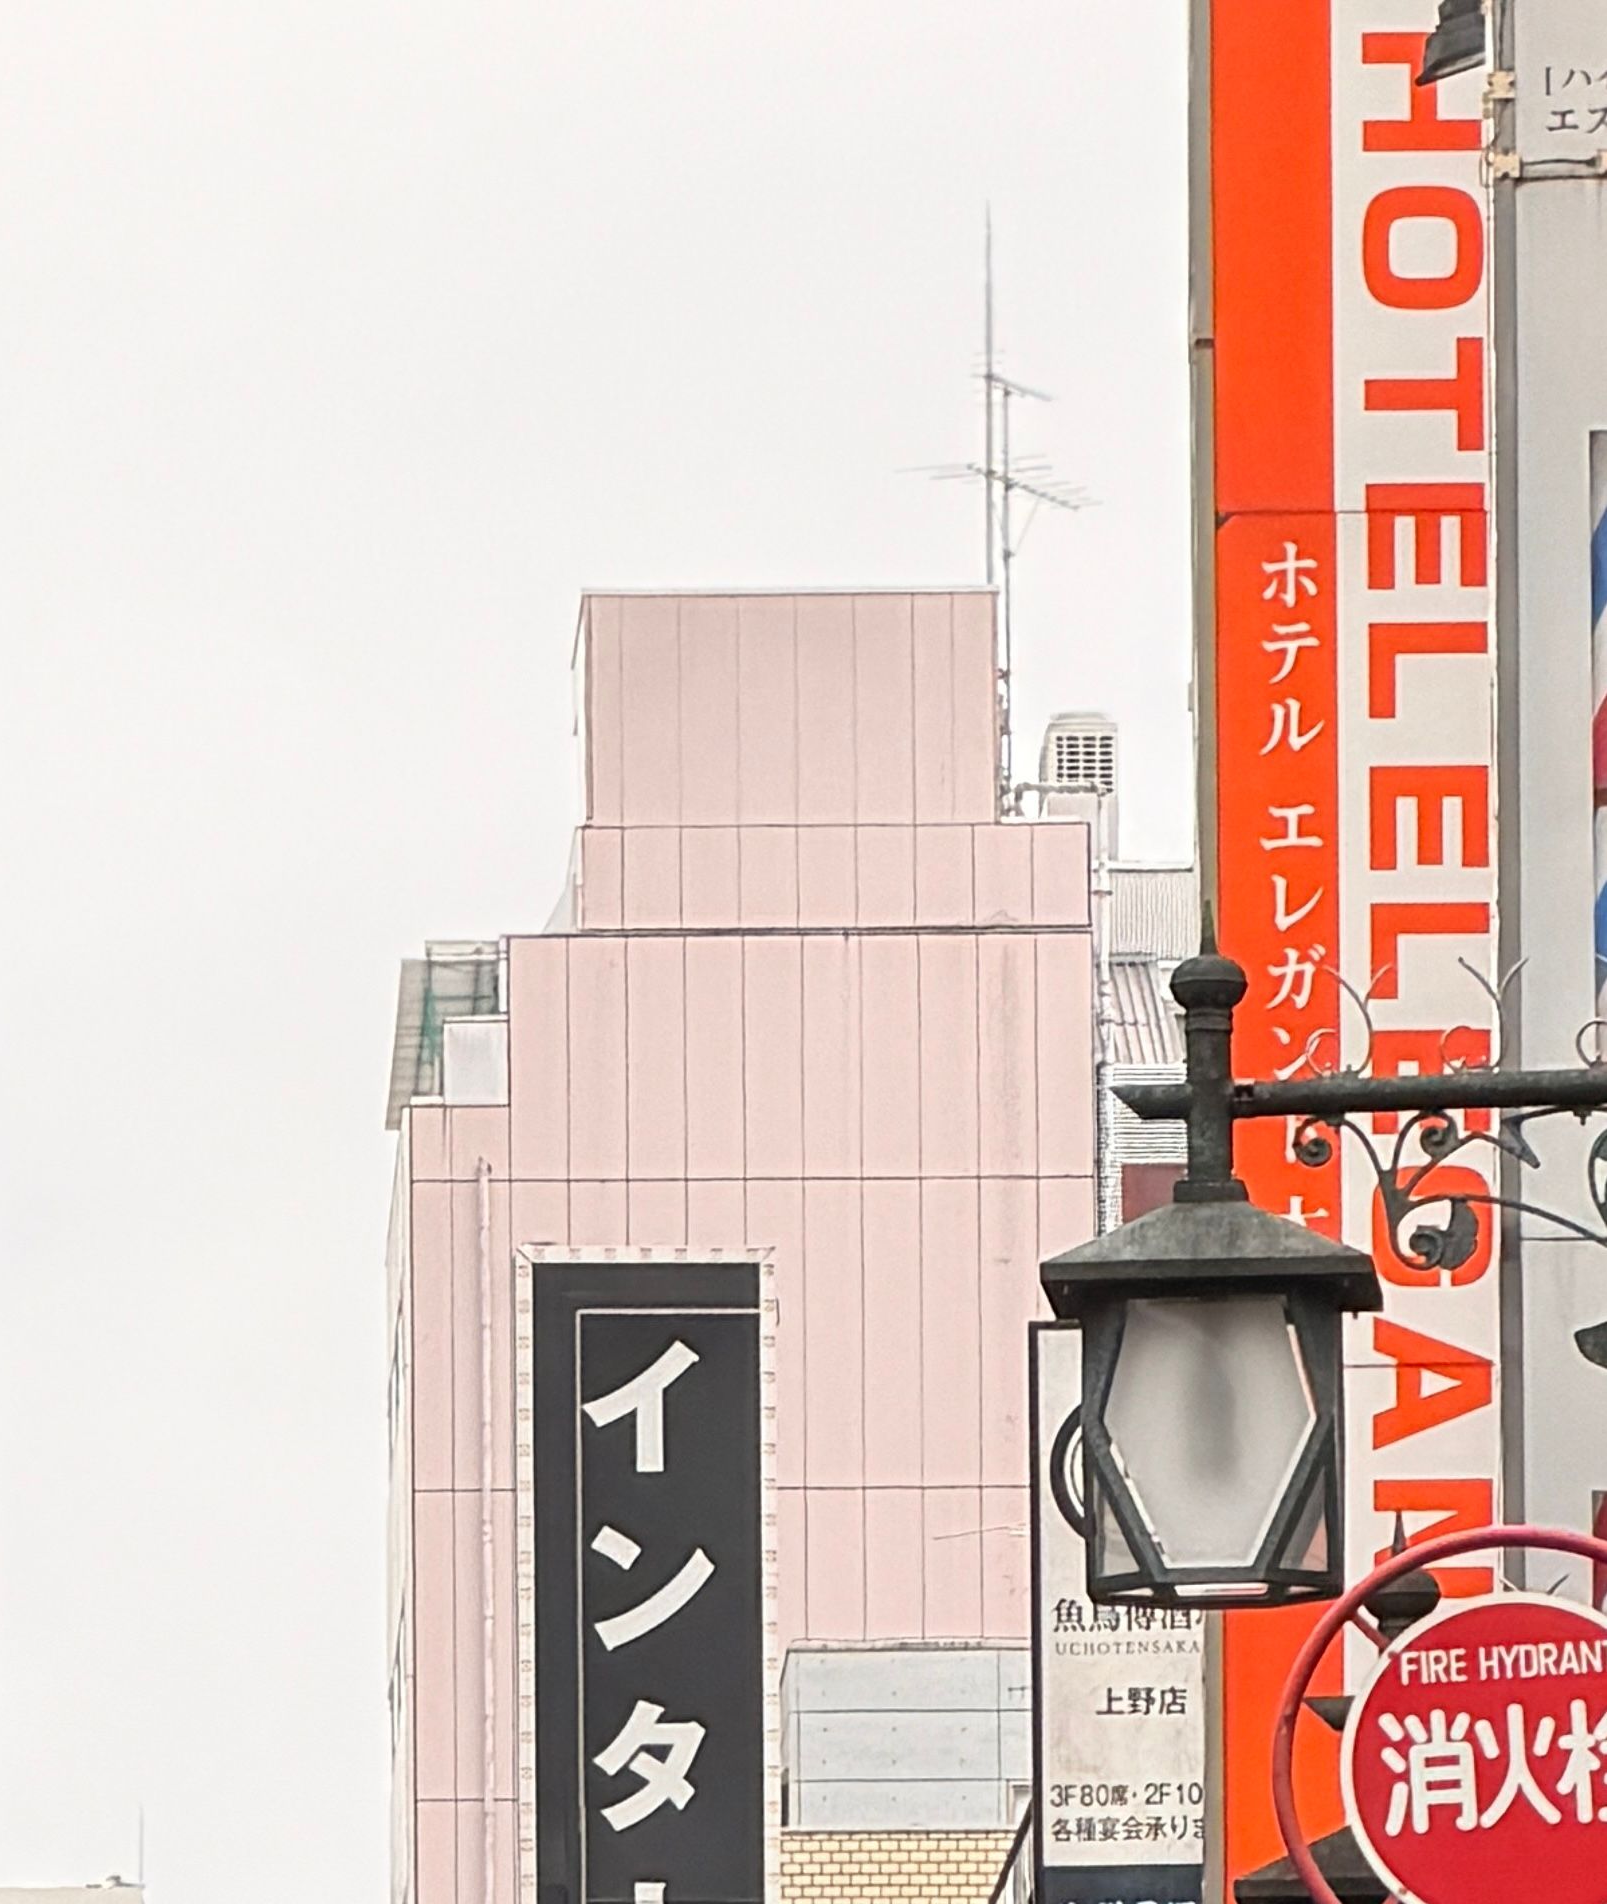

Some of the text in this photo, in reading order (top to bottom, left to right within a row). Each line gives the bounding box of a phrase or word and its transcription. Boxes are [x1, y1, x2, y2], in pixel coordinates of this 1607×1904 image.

[1401, 1648, 1468, 1686] FIRE
[1095, 1685, 1187, 1716] 上野店
